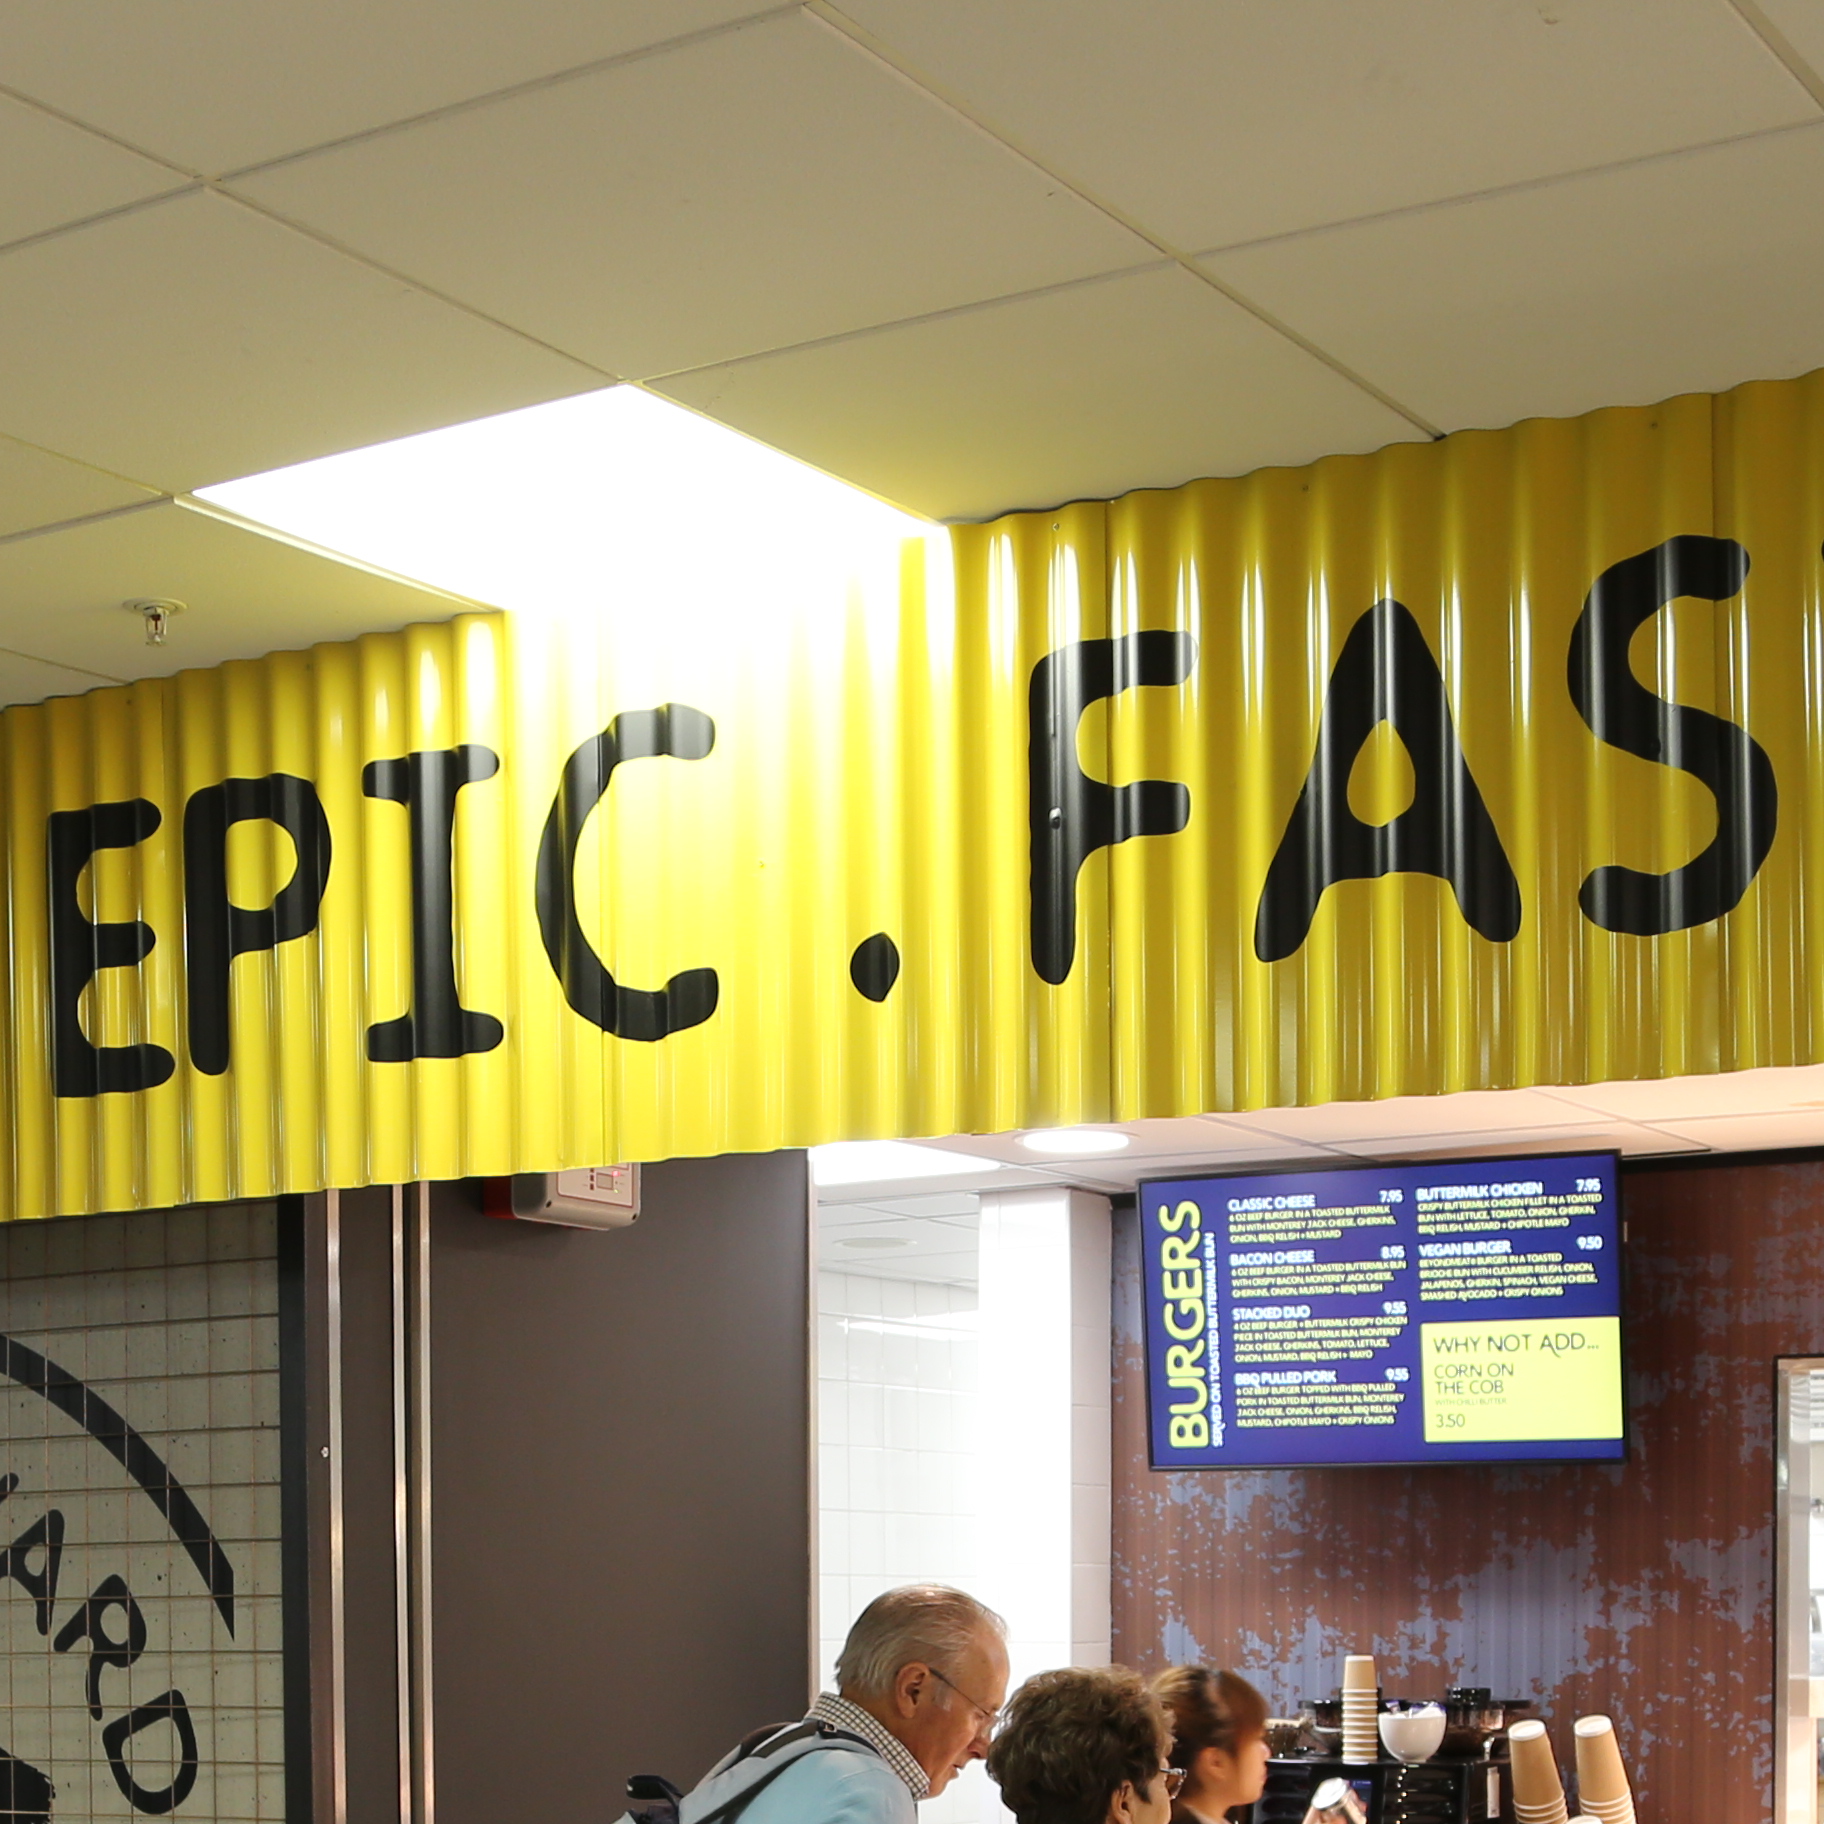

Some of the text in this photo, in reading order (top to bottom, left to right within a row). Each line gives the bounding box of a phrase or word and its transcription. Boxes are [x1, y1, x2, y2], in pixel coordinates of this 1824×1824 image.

[46, 703, 719, 1098] EPIC
[1416, 1182, 1543, 1201] BUTTERMILK CHICKEN
[1576, 1178, 1601, 1192] 7.95
[1228, 1194, 1316, 1212] CLASSIC CHEESE
[1379, 1189, 1403, 1203] 7.95
[1419, 1240, 1512, 1257] VEGAN BURGER
[1576, 1235, 1603, 1250] 9.50
[1230, 1250, 1315, 1266] BACON CHEESE
[1381, 1246, 1405, 1259] 8.95
[1232, 1305, 1311, 1320] STACKED DUO
[1383, 1301, 1407, 1315] 9.55
[1159, 1200, 1210, 1448] BURGERS
[1204, 1232, 1227, 1448] SERVED ON TOASTED BUTTERMILK BUN
[1433, 1335, 1480, 1353] WHY
[1487, 1334, 1532, 1352] NOT
[1234, 1370, 1337, 1387] BBQ PULLED PORK
[1385, 1368, 1410, 1381] 9.55
[1434, 1363, 1514, 1379] CORN ON
[1435, 1380, 1504, 1395] THE COB
[1435, 1398, 1455, 1406] WITH
[1436, 1413, 1466, 1428] 3.50
